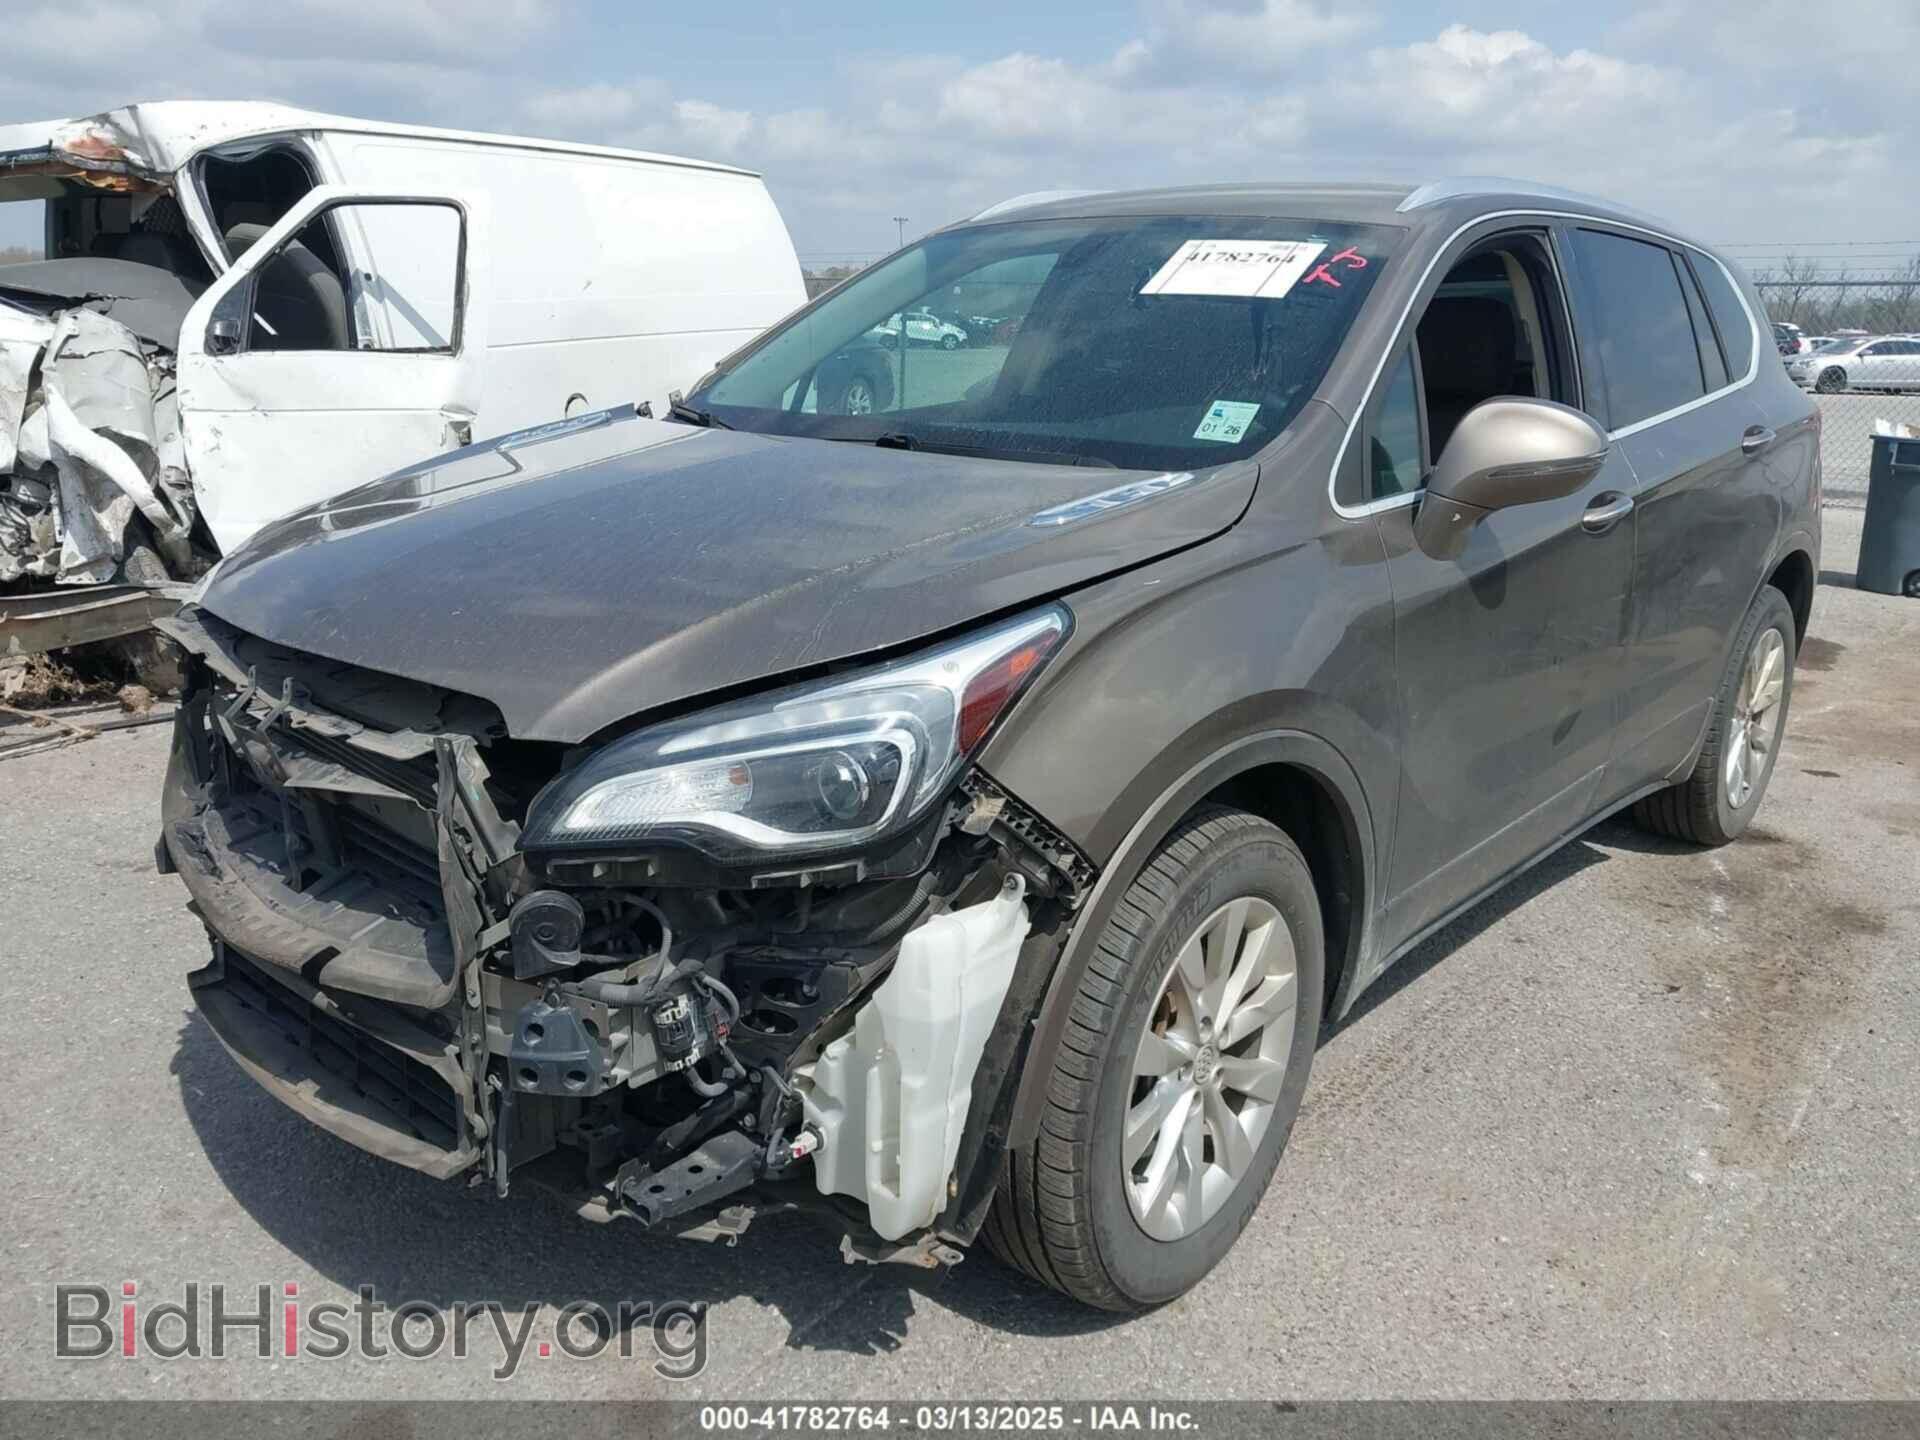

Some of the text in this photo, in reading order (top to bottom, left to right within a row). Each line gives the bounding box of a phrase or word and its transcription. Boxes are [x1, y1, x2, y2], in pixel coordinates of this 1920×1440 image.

[1185, 251, 1297, 264] 41782764
[1201, 422, 1242, 435] 01 26
